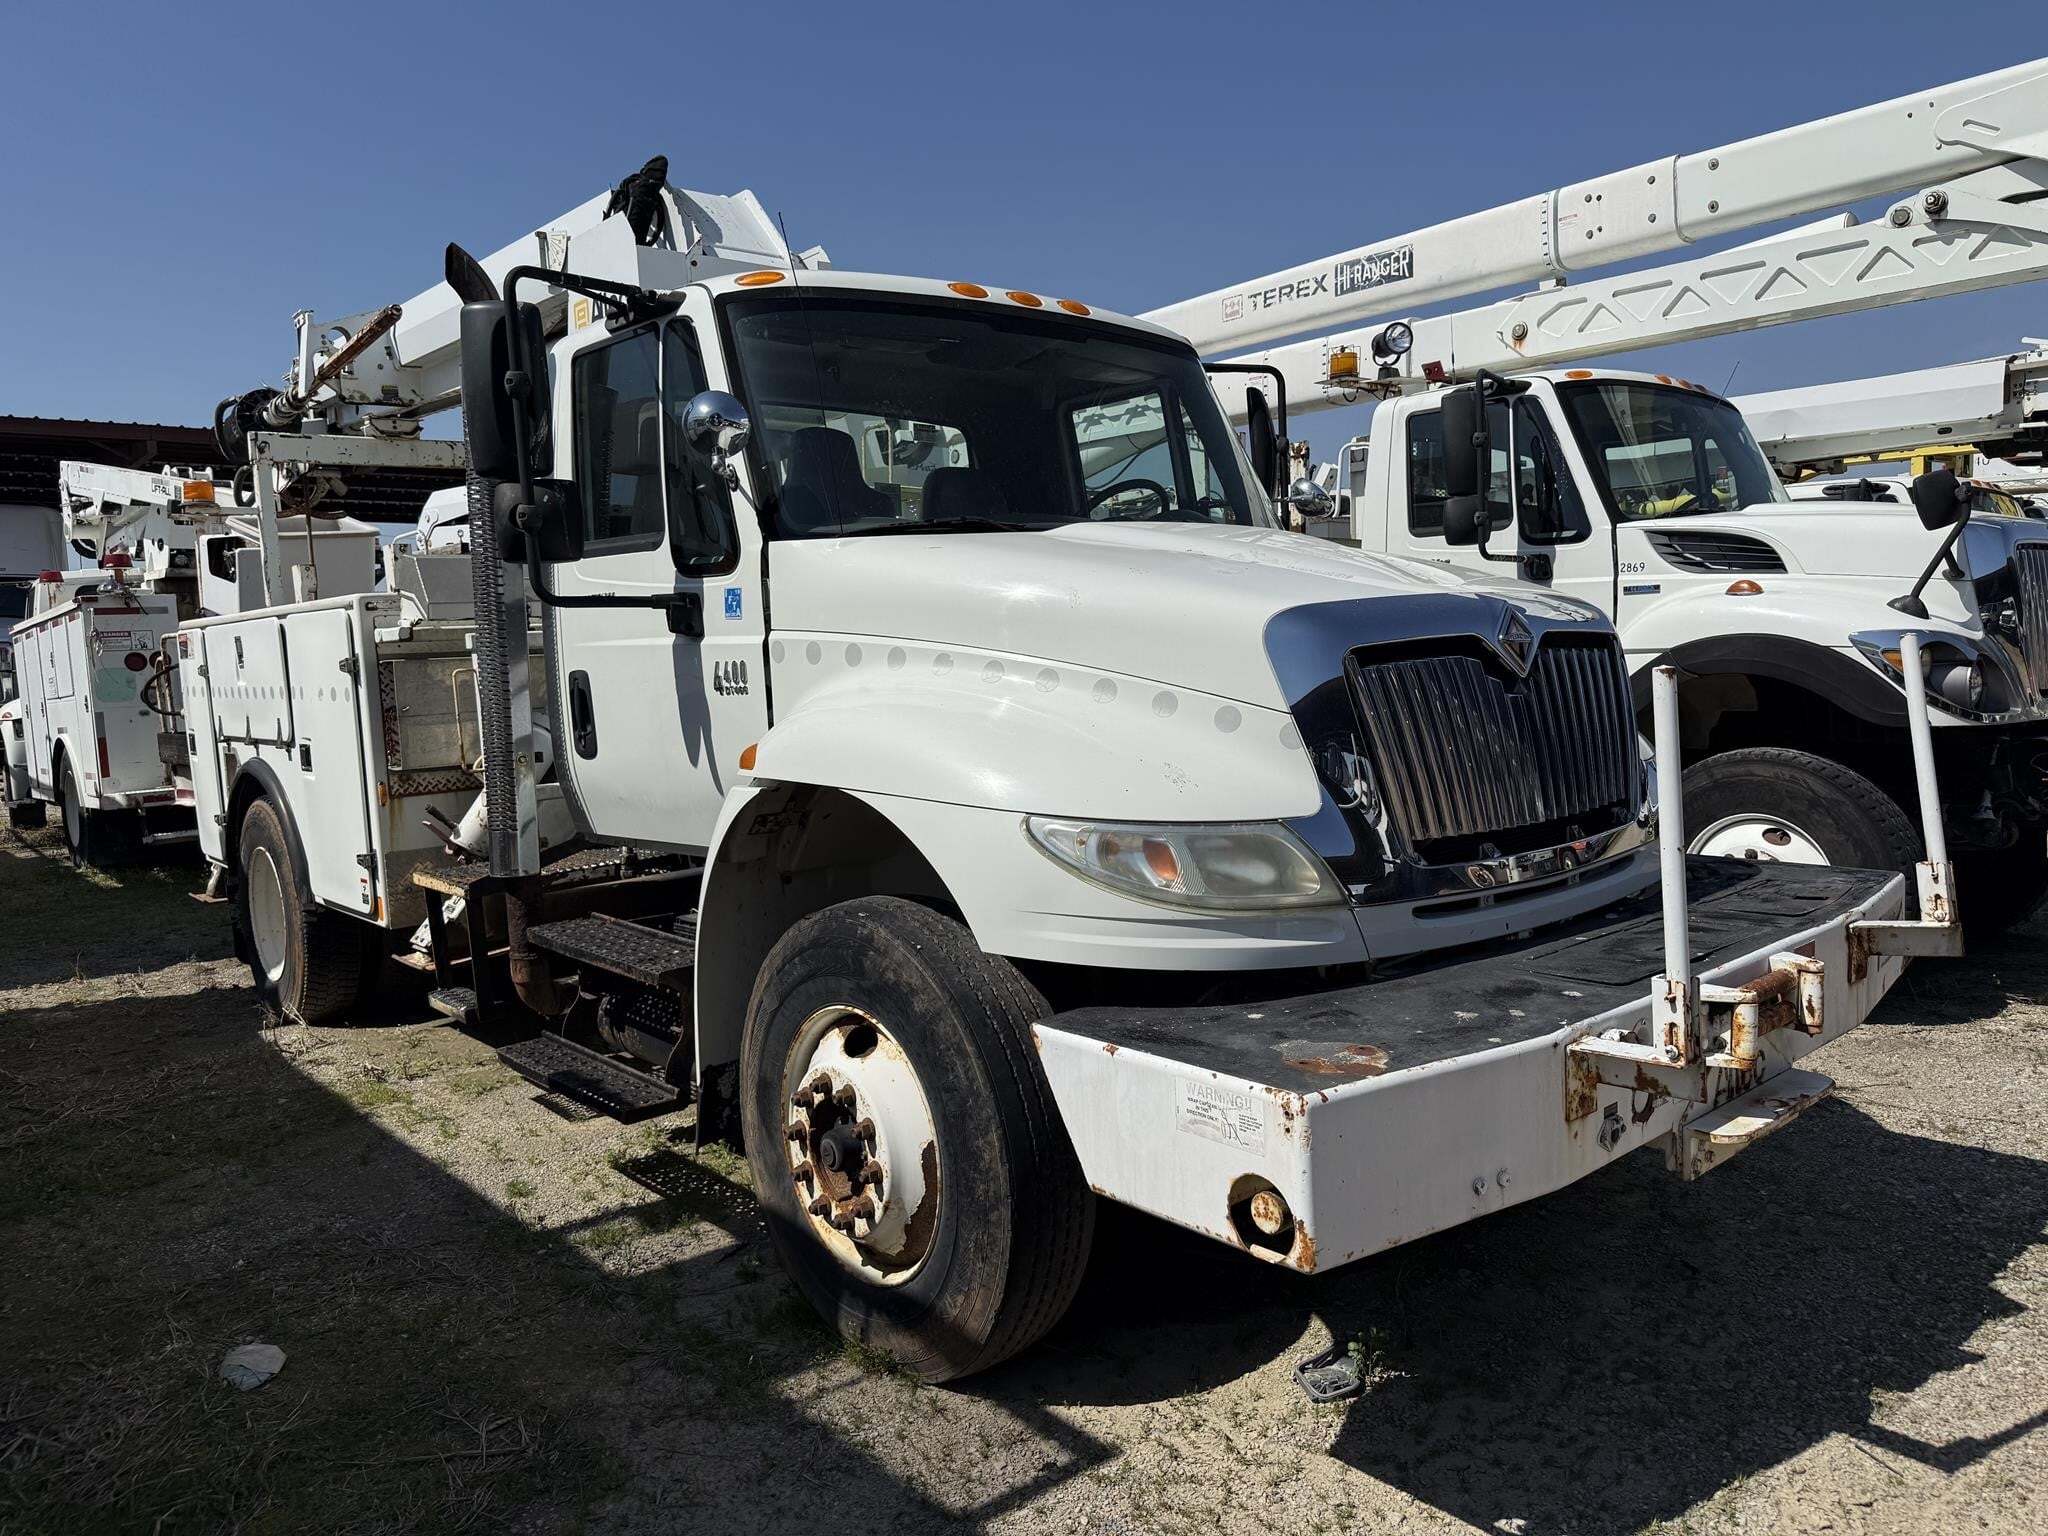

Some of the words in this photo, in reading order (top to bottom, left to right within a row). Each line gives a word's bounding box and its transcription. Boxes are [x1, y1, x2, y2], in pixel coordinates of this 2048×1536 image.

[1248, 273, 1329, 312] TEREX
[1337, 247, 1410, 295] HI-RANGER
[1620, 561, 1645, 573] 2869
[713, 659, 749, 697] 4400
